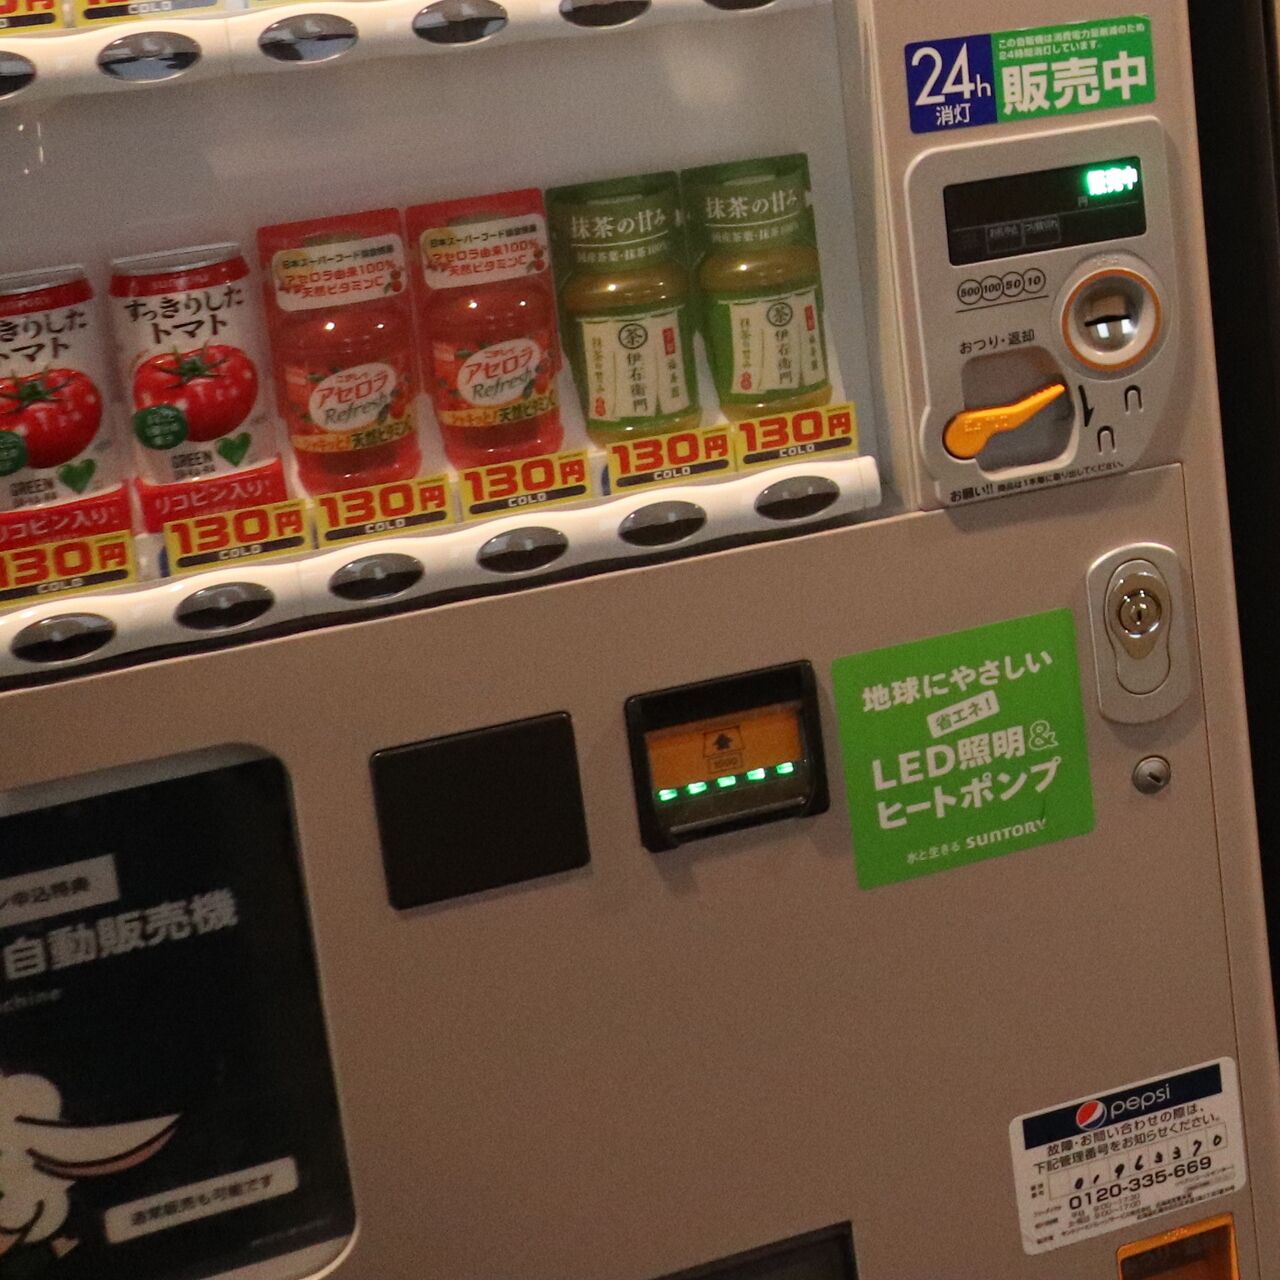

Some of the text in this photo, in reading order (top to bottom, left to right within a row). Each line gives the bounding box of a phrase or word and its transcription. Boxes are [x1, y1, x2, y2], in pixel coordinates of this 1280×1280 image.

[910, 42, 992, 107] 24h
[1001, 50, 1147, 116] 販売中
[935, 103, 972, 126] 消灯
[570, 208, 667, 239] 抹茶の甘み
[704, 186, 799, 218] 抹茶の甘み
[125, 286, 245, 322] すっきりした
[1005, 278, 1021, 290] 50
[1027, 275, 1041, 287] 10
[151, 315, 228, 344] トマト
[959, 329, 1035, 355] おつり・返却
[464, 346, 534, 385] アセロラ
[626, 351, 648, 413] 伊右衛門
[739, 409, 852, 452] 130円
[779, 443, 815, 458] COLD
[612, 431, 728, 476] 130円
[862, 648, 1053, 713] 地球にやさしい
[934, 696, 996, 732] 省エネ!
[877, 755, 1063, 830] ヒートポンプ
[906, 817, 1048, 866] 水と生きる SUNTORY
[3, 886, 240, 980] 自動販売機
[1110, 1083, 1172, 1120] pepsi
[1034, 1113, 1221, 1175] 下記管理番号をお知らせください。
[1047, 1103, 1205, 1157] 故障・お問い合わせの際は、
[1069, 1155, 1212, 1210] 0120-335-669
